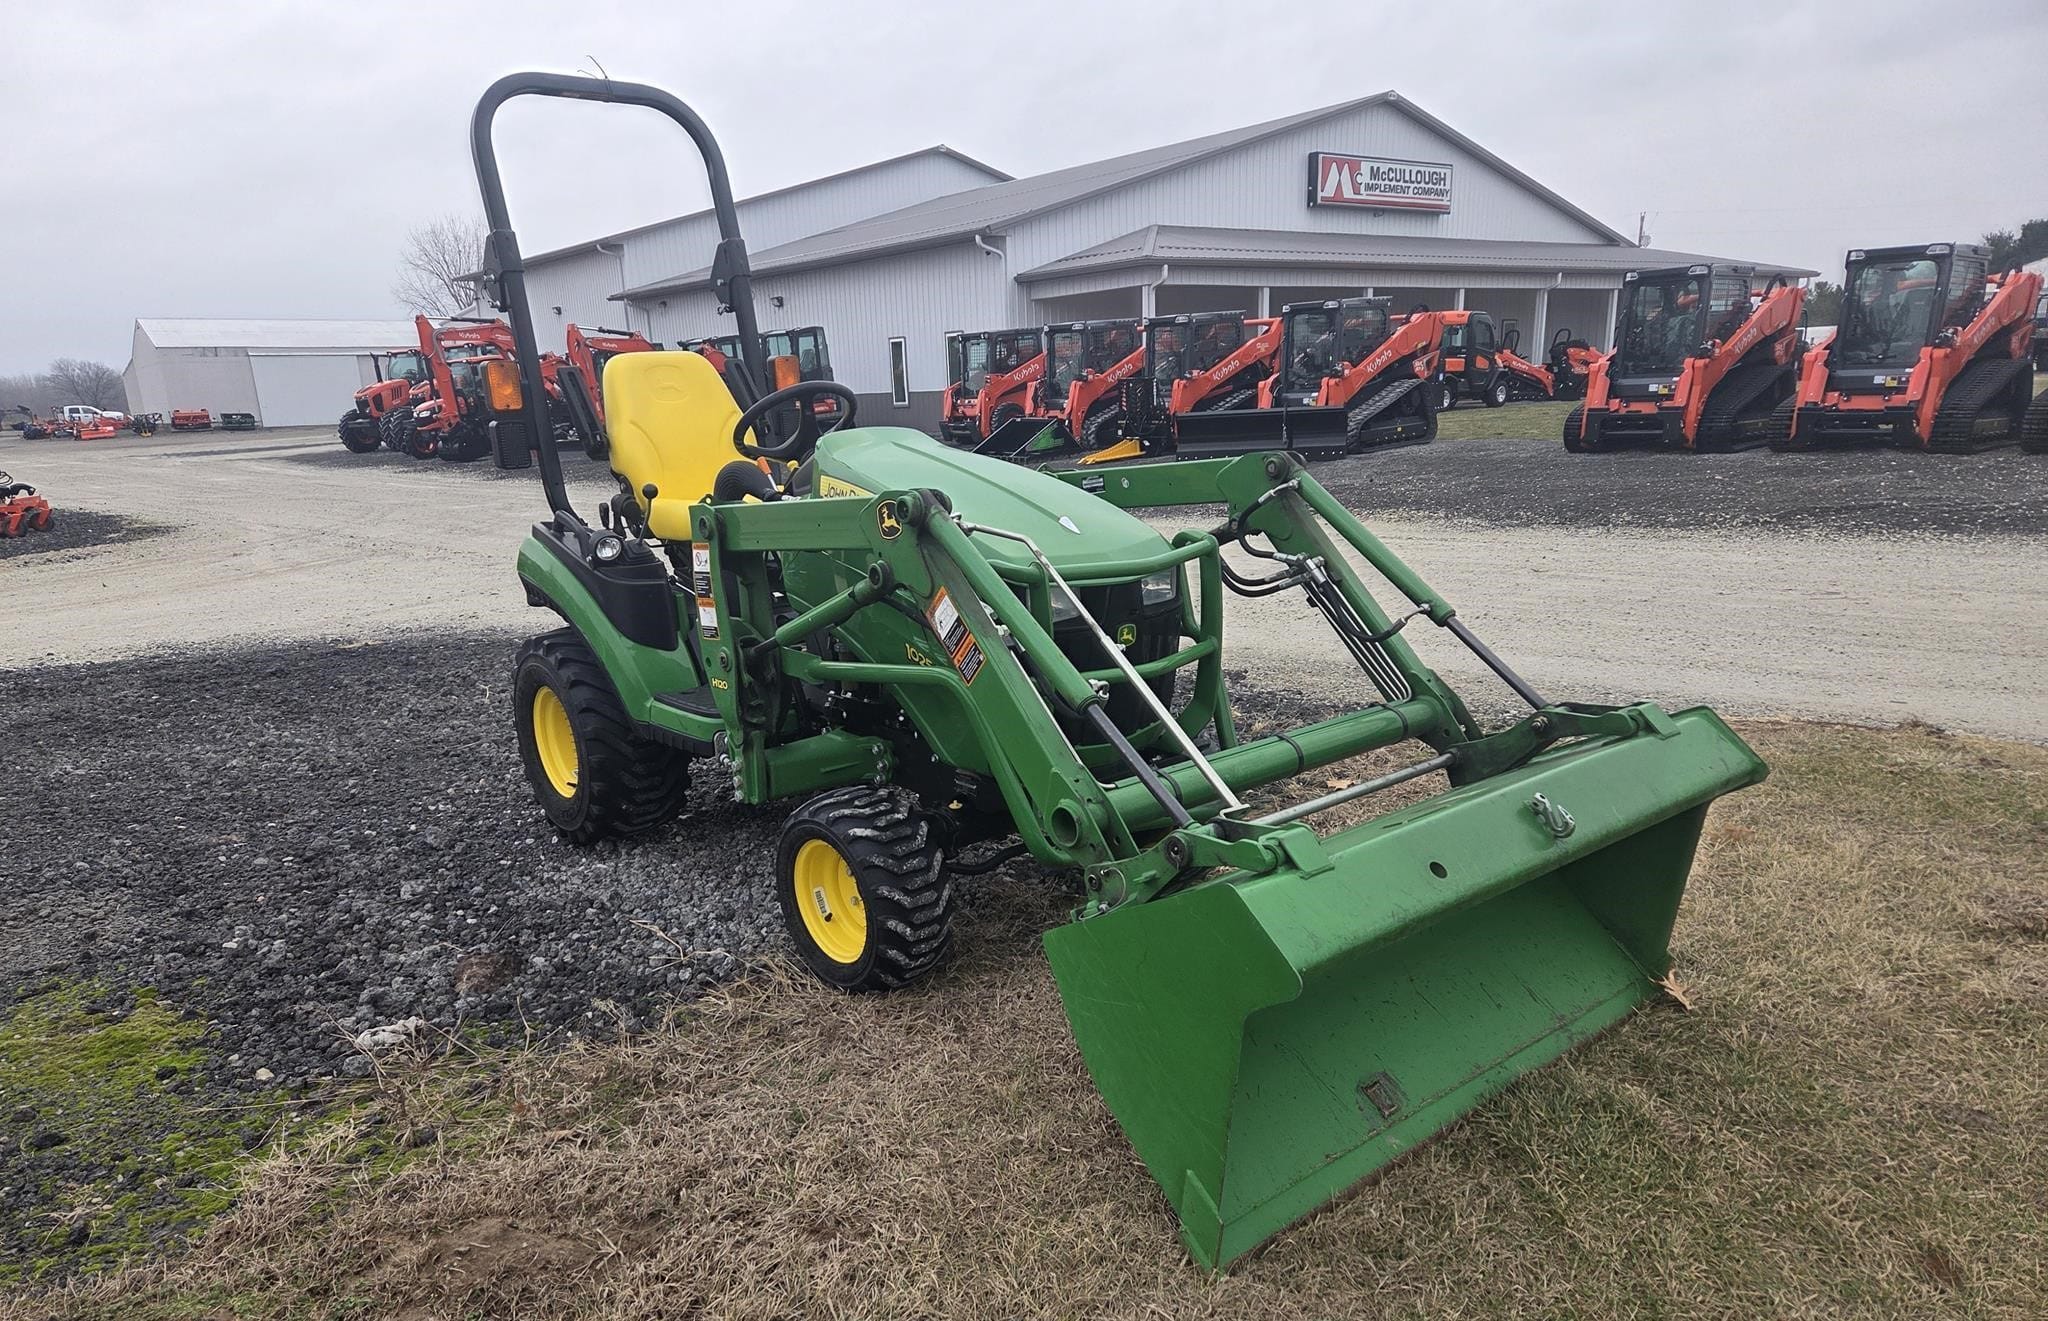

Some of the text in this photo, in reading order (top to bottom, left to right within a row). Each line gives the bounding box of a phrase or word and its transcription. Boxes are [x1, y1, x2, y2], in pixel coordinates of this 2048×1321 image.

[1370, 166, 1447, 187] McCULLOUGH
[1364, 183, 1450, 198] IMPLEMENT COMPANY
[1212, 360, 1240, 381] Kubota
[1366, 349, 1392, 373] Kubota
[1013, 363, 1040, 381] Kubota
[1106, 362, 1133, 383] Kubota
